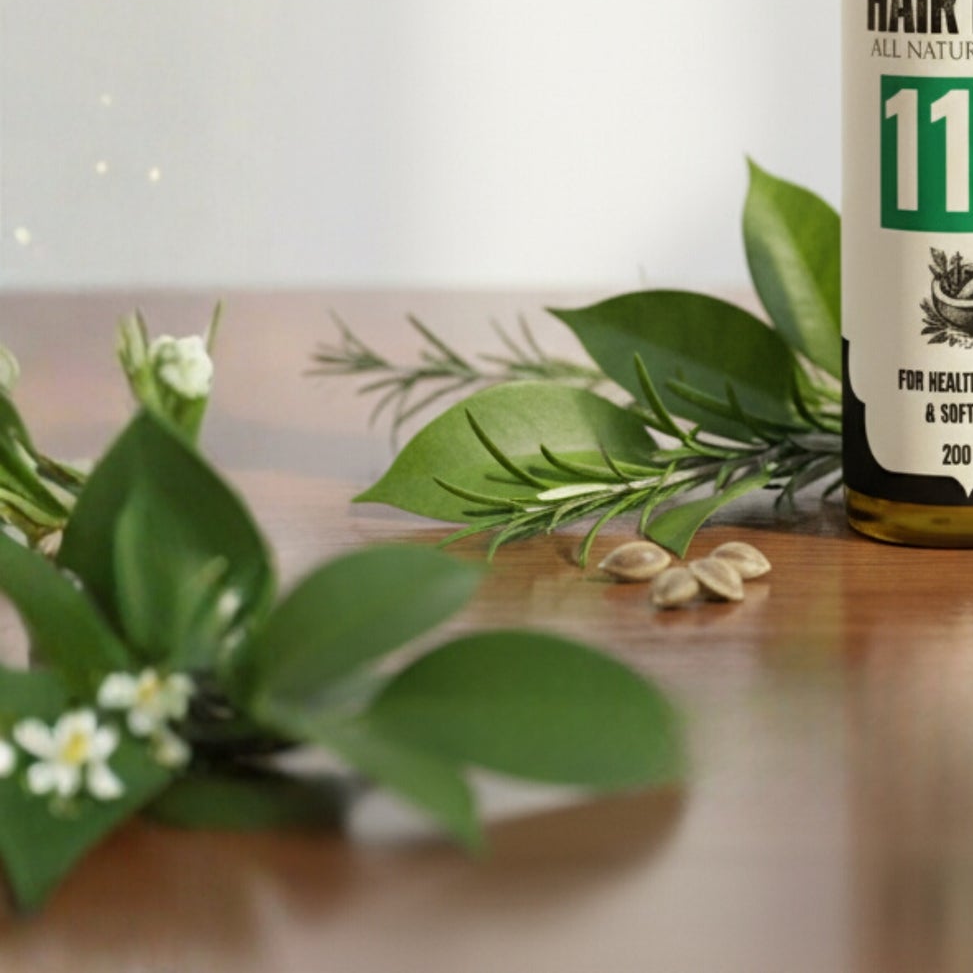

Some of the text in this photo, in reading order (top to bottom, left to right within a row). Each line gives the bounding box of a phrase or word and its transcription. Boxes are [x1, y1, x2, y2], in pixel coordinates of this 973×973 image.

[871, 38, 901, 58] ALL
[885, 88, 970, 213] 11
[898, 369, 924, 391] FOR
[925, 402, 936, 423] &
[942, 444, 971, 465] 200
